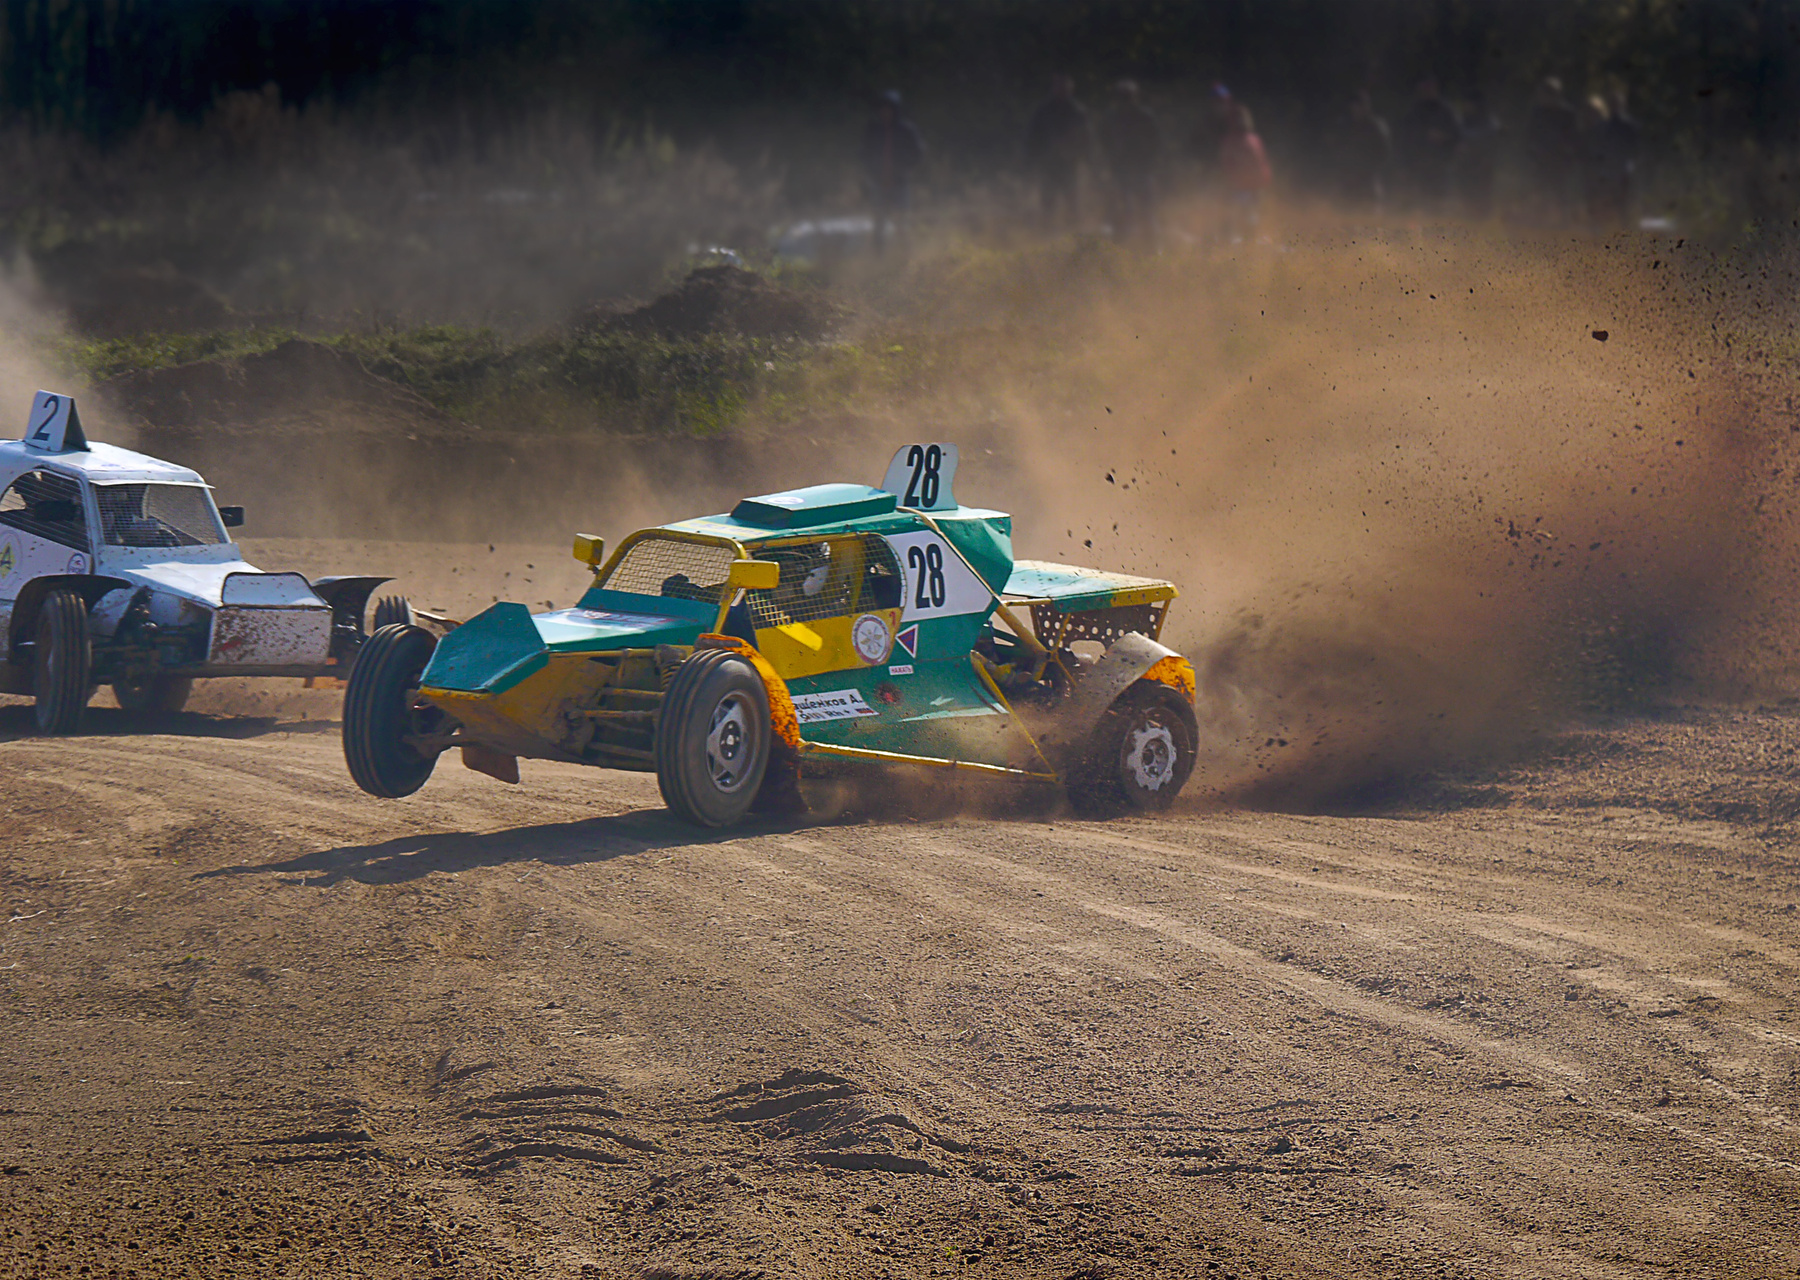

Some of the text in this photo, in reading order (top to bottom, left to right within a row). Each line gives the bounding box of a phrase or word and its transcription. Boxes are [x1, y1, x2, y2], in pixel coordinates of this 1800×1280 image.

[32, 395, 60, 442] 2
[903, 444, 942, 508] 28
[907, 543, 946, 609] 28
